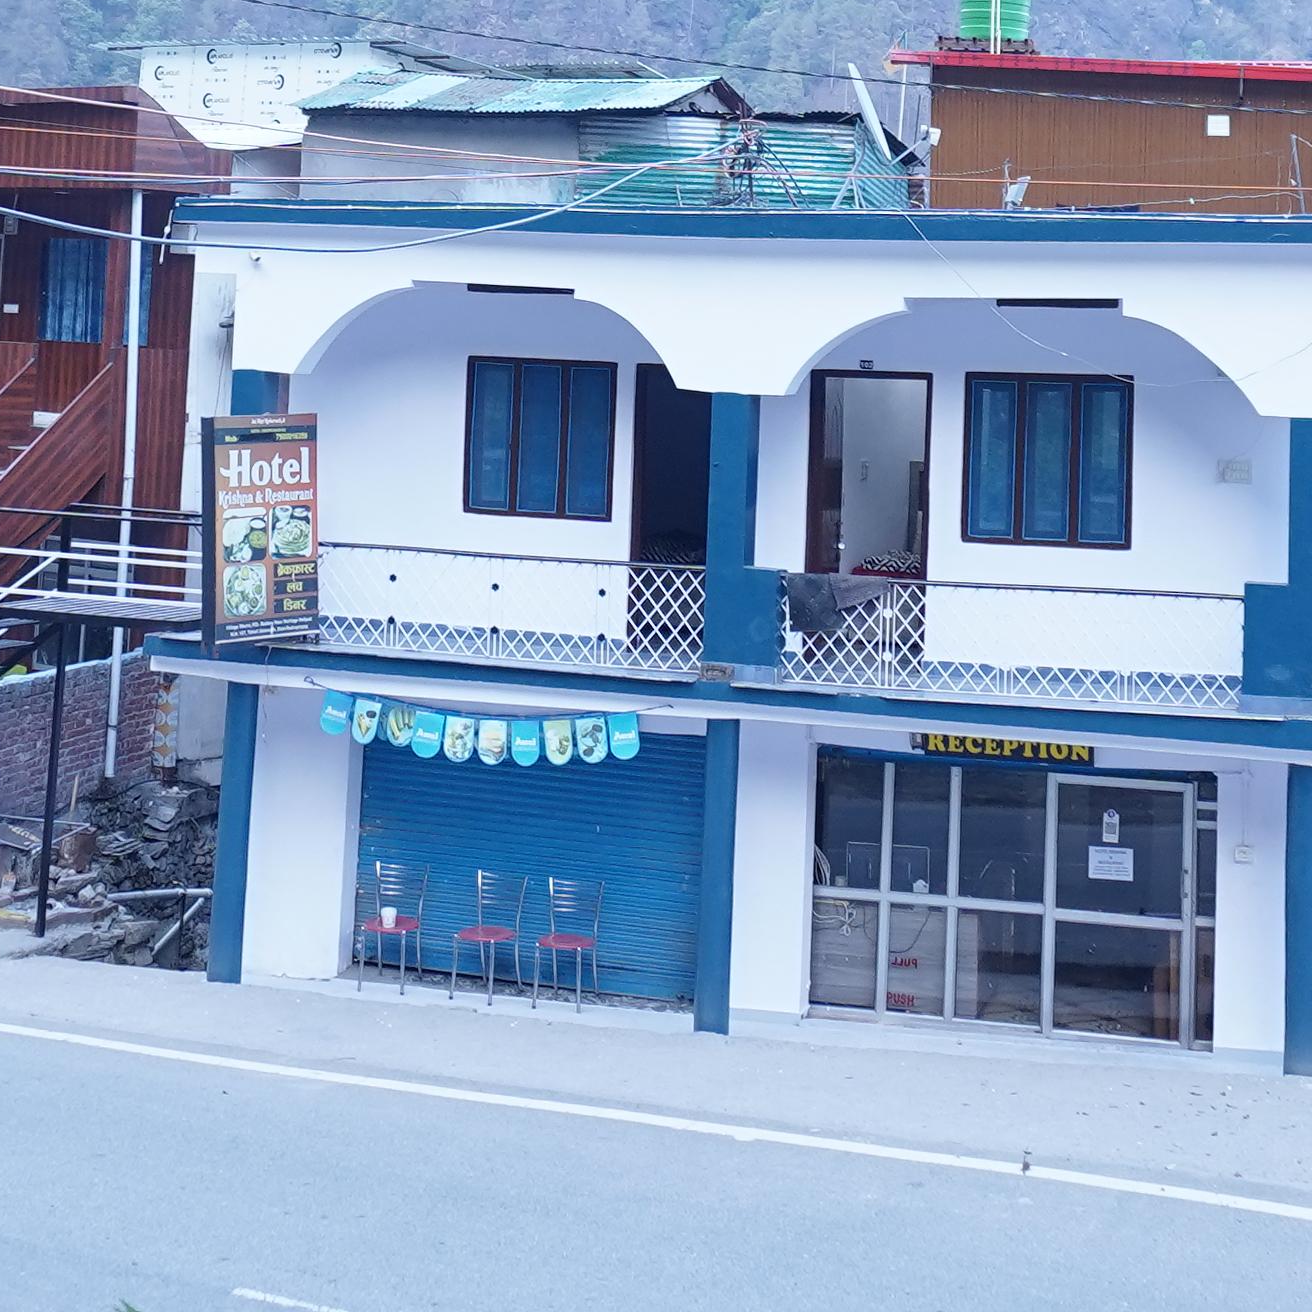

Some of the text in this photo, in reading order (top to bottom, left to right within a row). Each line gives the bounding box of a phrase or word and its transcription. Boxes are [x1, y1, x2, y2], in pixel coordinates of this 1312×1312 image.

[219, 446, 311, 487] Hotel
[219, 488, 313, 508] Krishna & Restaurant
[927, 733, 1089, 761] RECEPTION
